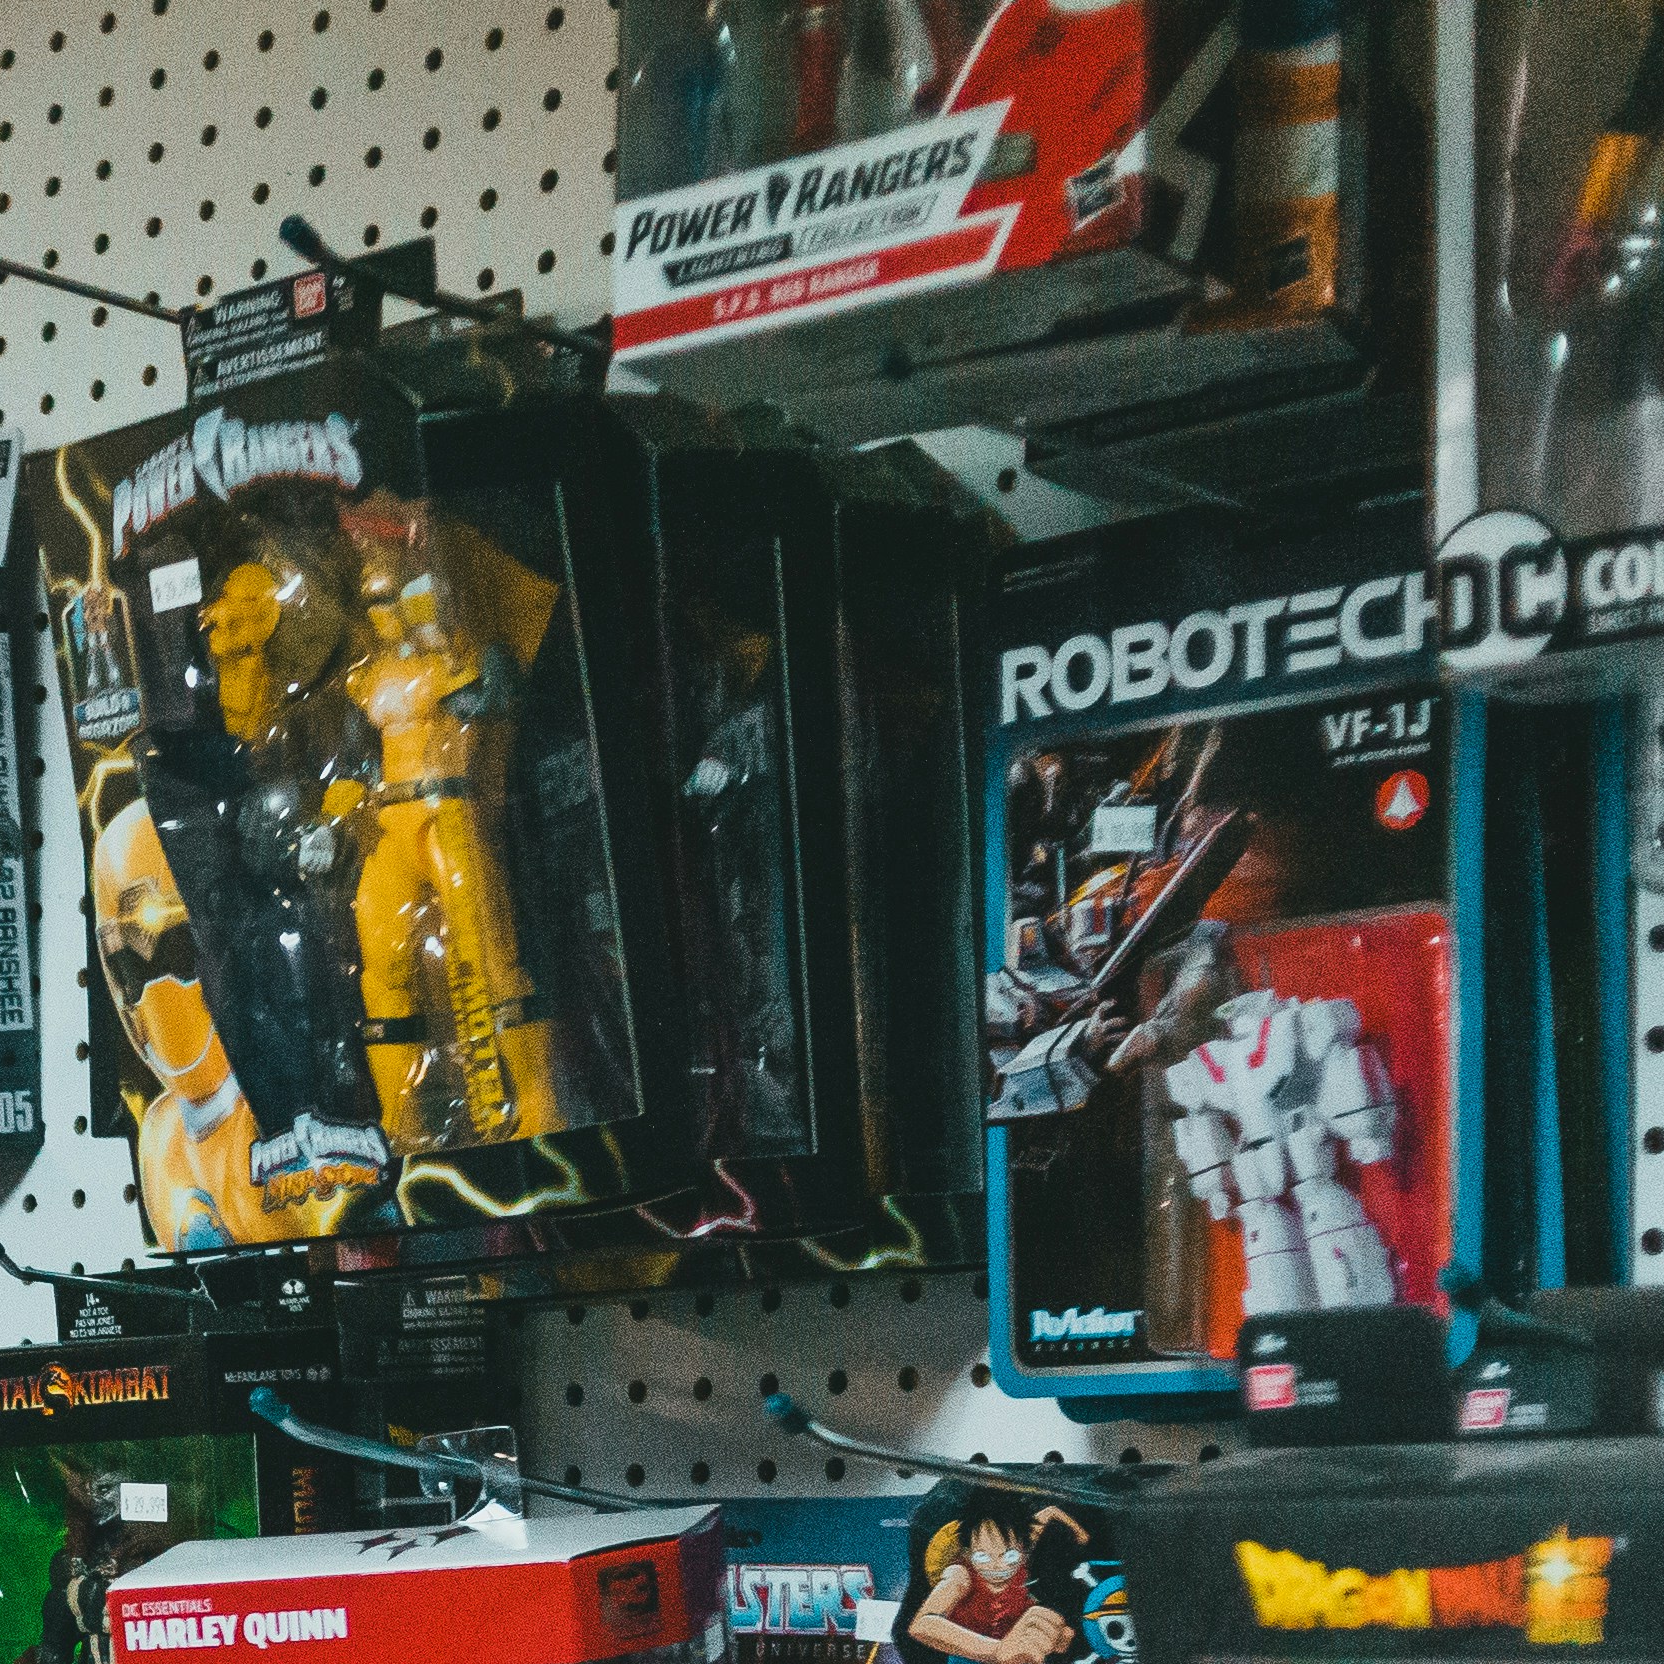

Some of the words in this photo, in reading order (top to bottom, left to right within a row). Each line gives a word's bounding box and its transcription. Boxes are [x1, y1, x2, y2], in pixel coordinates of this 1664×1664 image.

[625, 191, 758, 263] POWER
[794, 131, 977, 219] RANGERS
[1000, 570, 1439, 726] ROBOTECH
[1324, 699, 1432, 750] VF-1J
[66, 1364, 170, 1408] KOMBAT
[122, 1603, 139, 1618] DC
[141, 1599, 213, 1618] ESSENTIALS
[727, 1564, 873, 1637] STERS
[1235, 1539, 1432, 1630] DRAGON
[124, 1615, 238, 1652] HARLEY
[244, 1607, 348, 1649] QUINN
